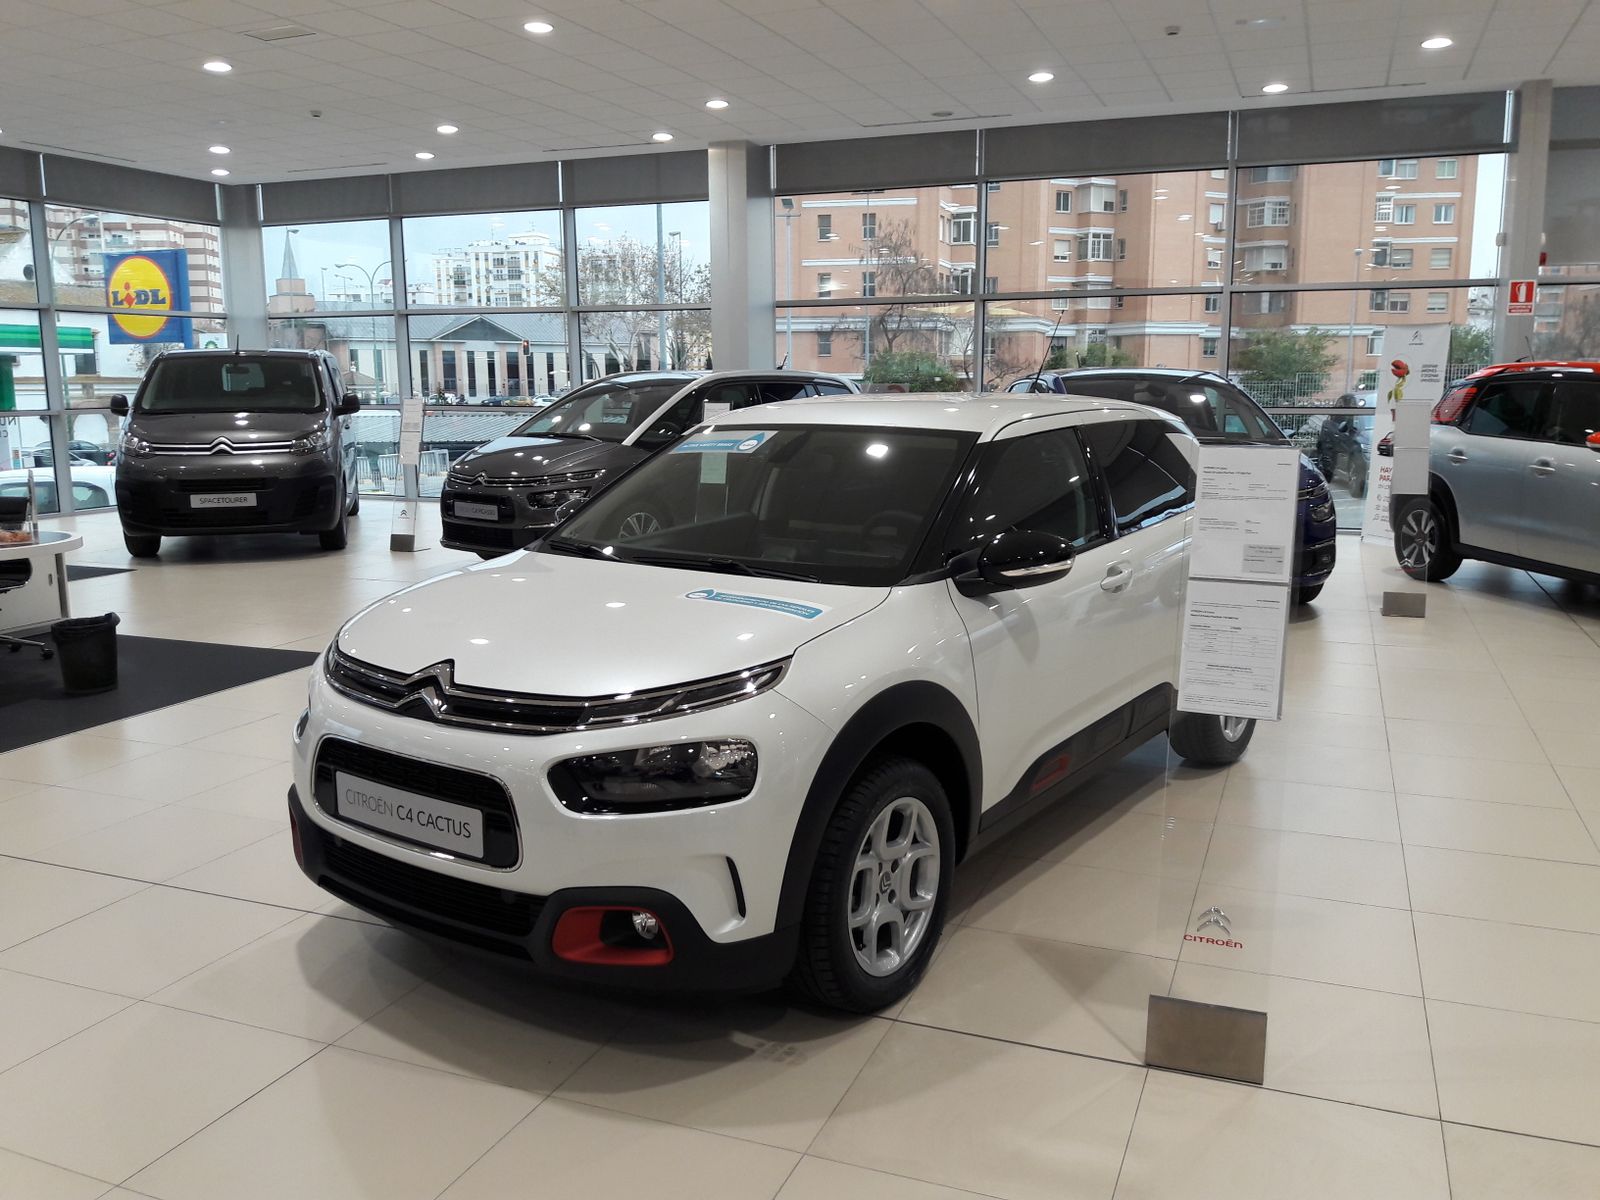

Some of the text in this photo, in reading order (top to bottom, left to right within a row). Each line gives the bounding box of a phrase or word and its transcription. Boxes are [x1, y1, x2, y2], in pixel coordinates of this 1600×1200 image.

[199, 496, 248, 505] SPACETOURER
[345, 788, 472, 839] CITROËN C4 CACTUS
